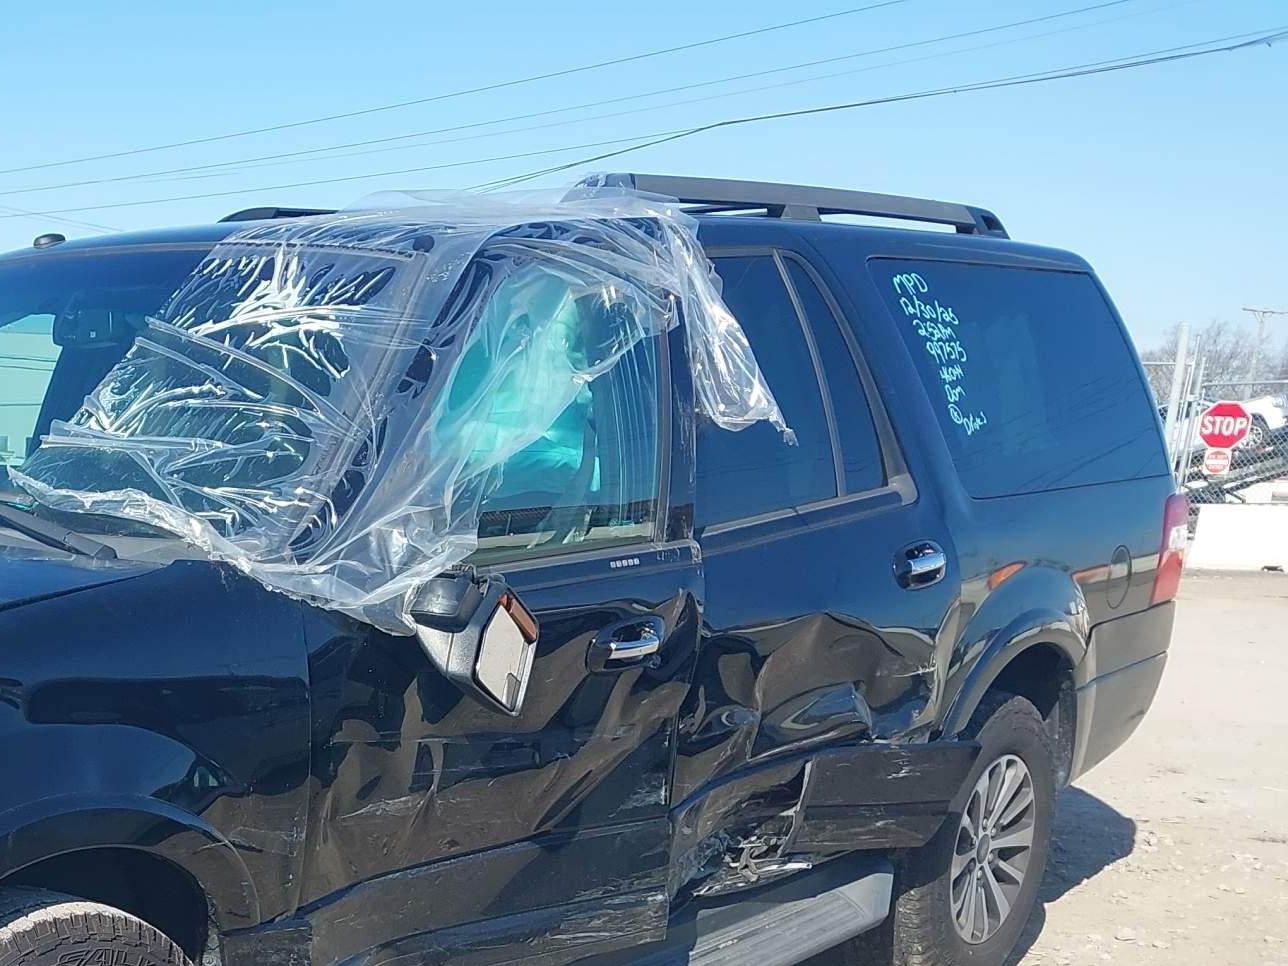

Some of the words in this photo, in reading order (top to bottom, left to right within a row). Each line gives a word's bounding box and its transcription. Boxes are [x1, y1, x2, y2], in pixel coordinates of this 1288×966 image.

[893, 273, 928, 295] MPD
[899, 295, 959, 325] 12/30/25
[926, 341, 967, 363] 997575
[1201, 415, 1248, 436] STOP
